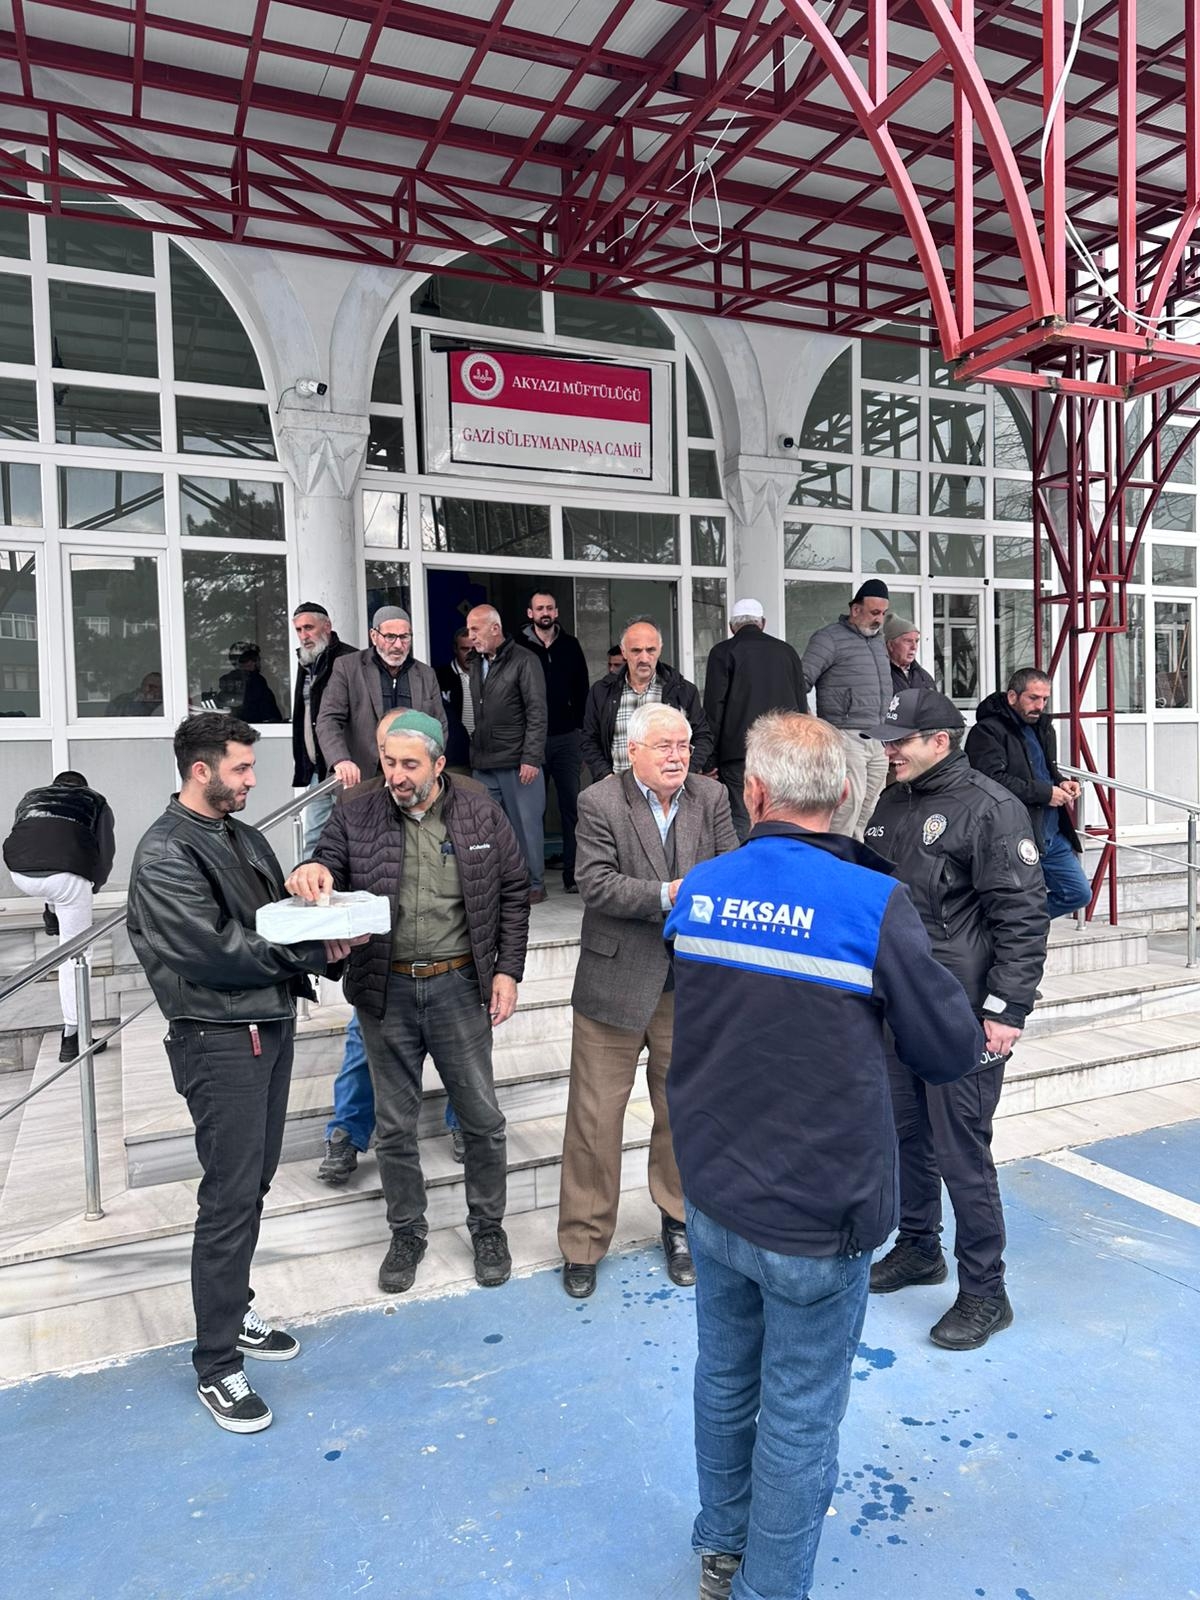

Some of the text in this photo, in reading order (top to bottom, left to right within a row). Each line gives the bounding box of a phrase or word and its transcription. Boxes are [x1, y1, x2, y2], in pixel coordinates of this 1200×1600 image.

[512, 375, 560, 393] AKYAZI
[562, 381, 641, 402] MÜFTÜLÜĞÜ
[463, 427, 495, 444] GAZİ
[497, 429, 602, 456] SÜLEYMANPAŞA
[721, 898, 814, 930] EKSAN
